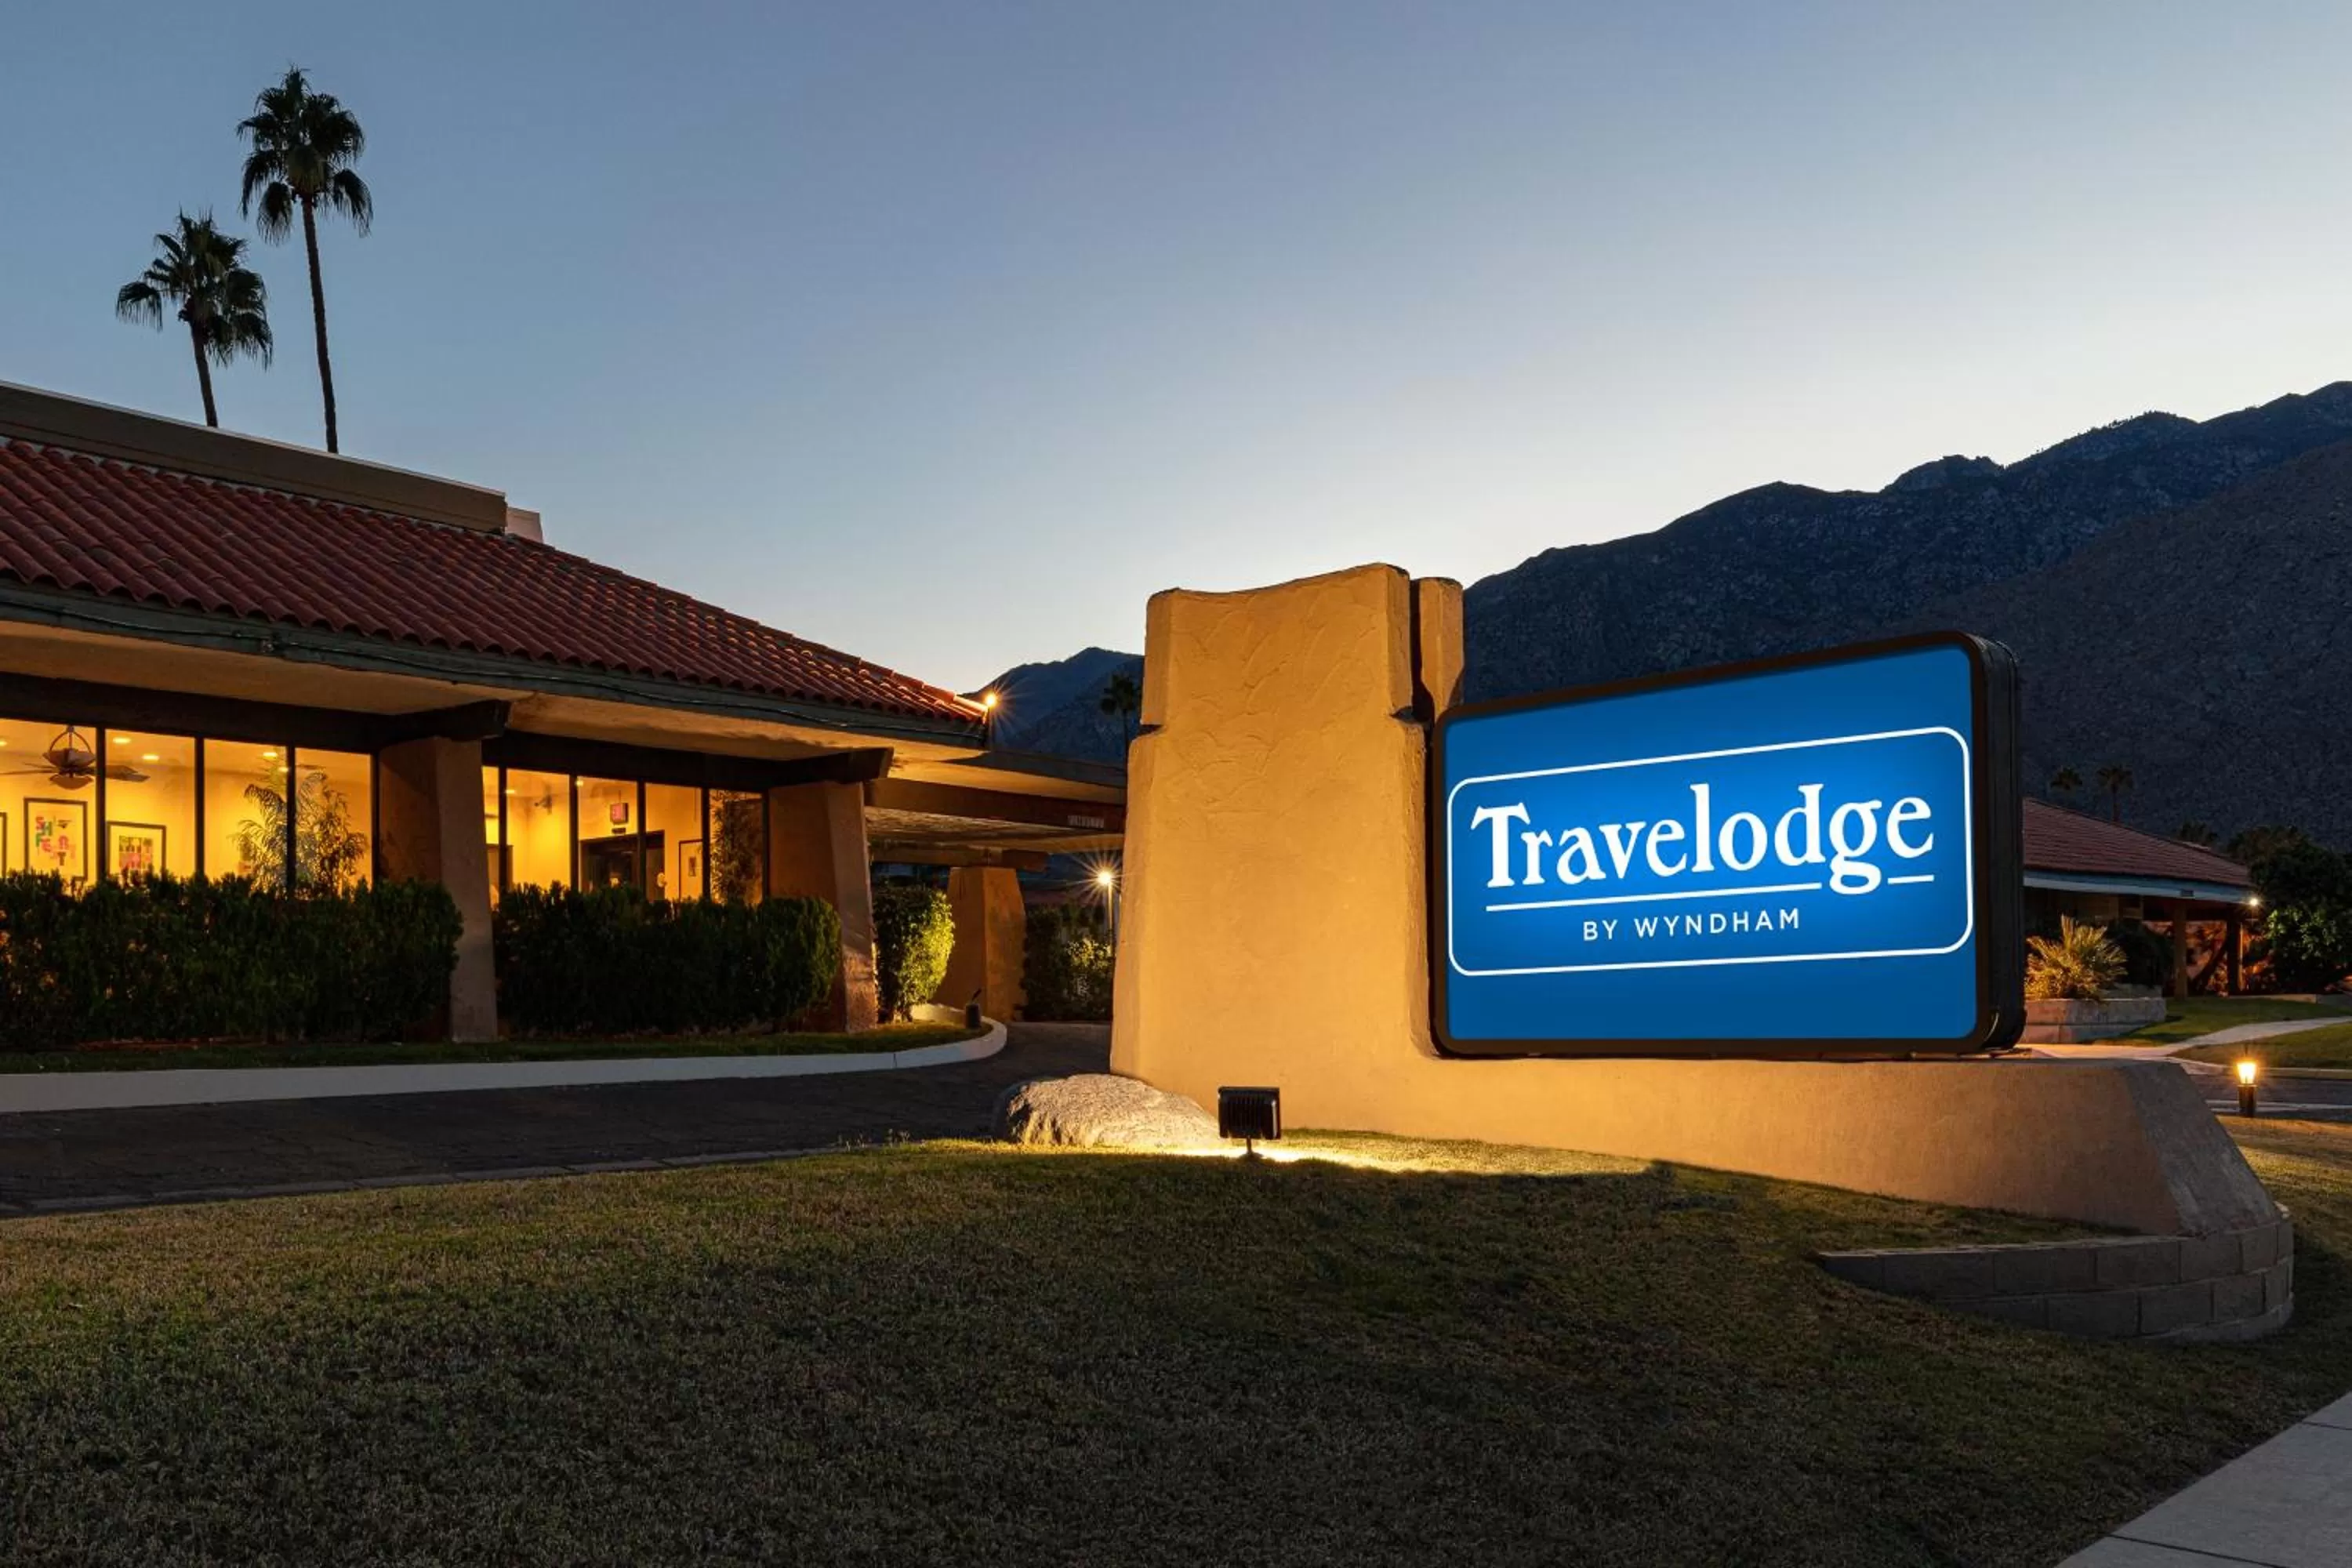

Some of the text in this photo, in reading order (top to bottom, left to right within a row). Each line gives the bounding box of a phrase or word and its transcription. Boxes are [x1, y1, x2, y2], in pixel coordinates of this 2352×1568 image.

[1470, 783, 1934, 895] Travelodge
[1583, 908, 1800, 941] BY WYNDHAM
